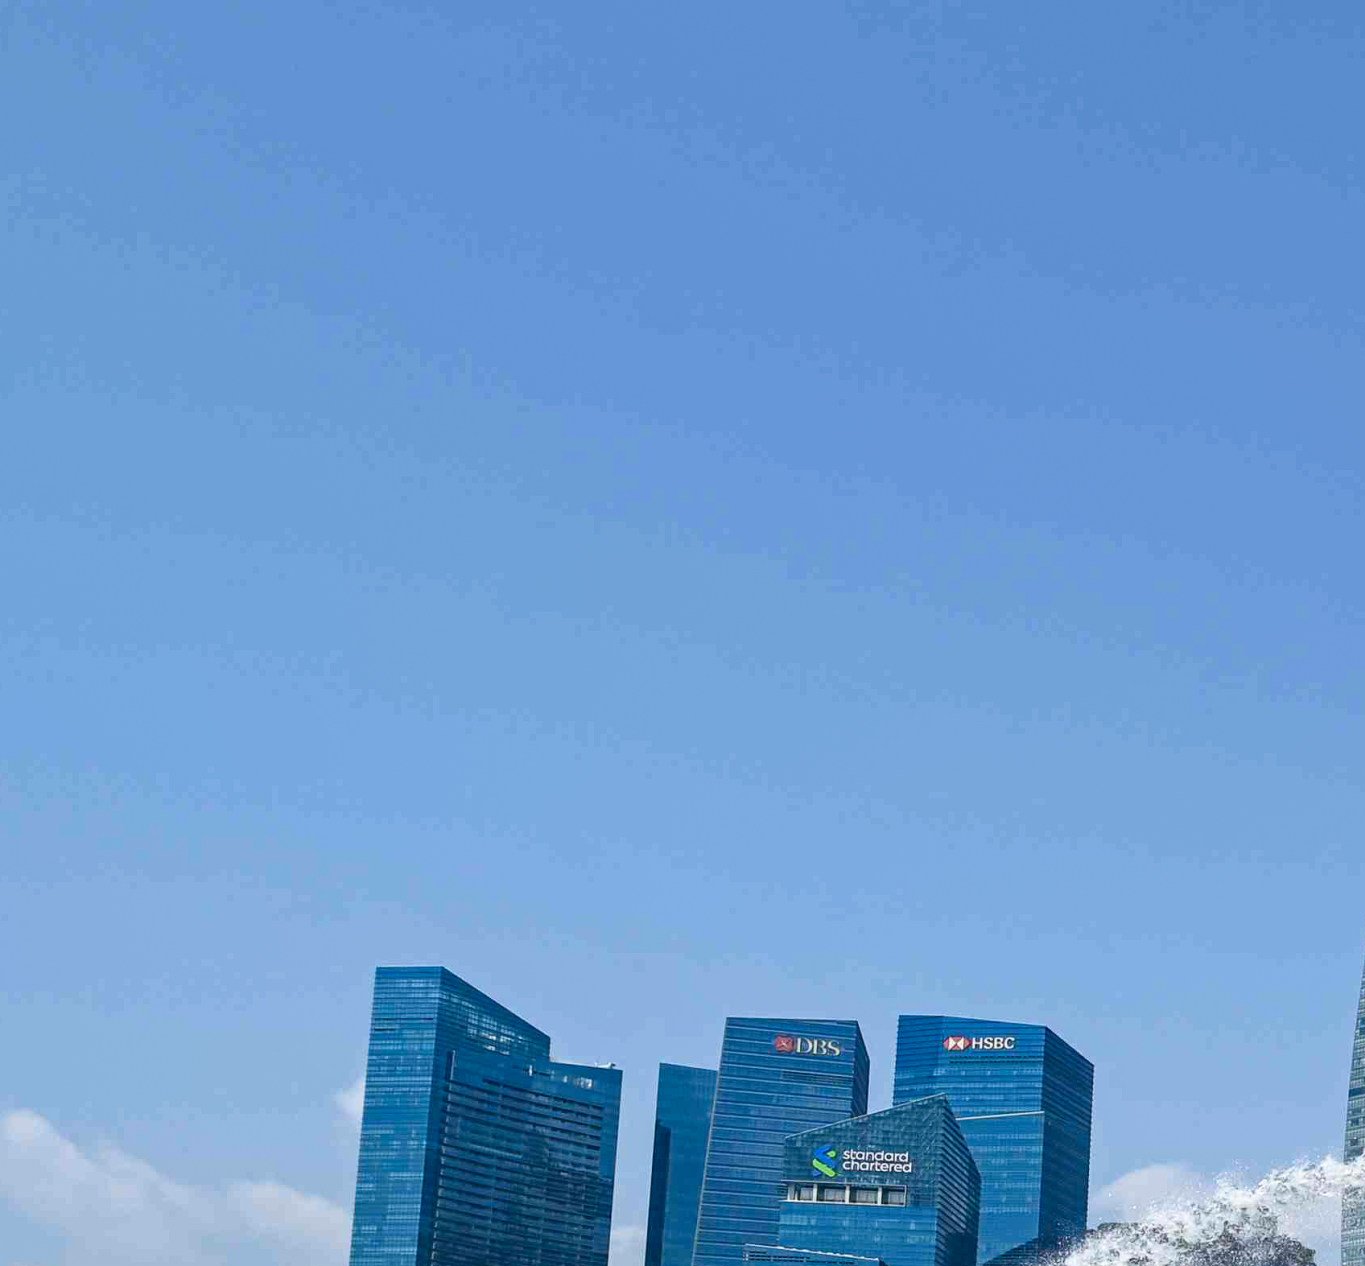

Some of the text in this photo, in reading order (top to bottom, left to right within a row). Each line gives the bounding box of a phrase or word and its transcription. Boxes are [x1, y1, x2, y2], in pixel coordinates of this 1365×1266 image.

[796, 1037, 841, 1056] DBS
[971, 1036, 1016, 1050] HSBC
[842, 1149, 909, 1163] standard
[842, 1161, 913, 1174] chartered
